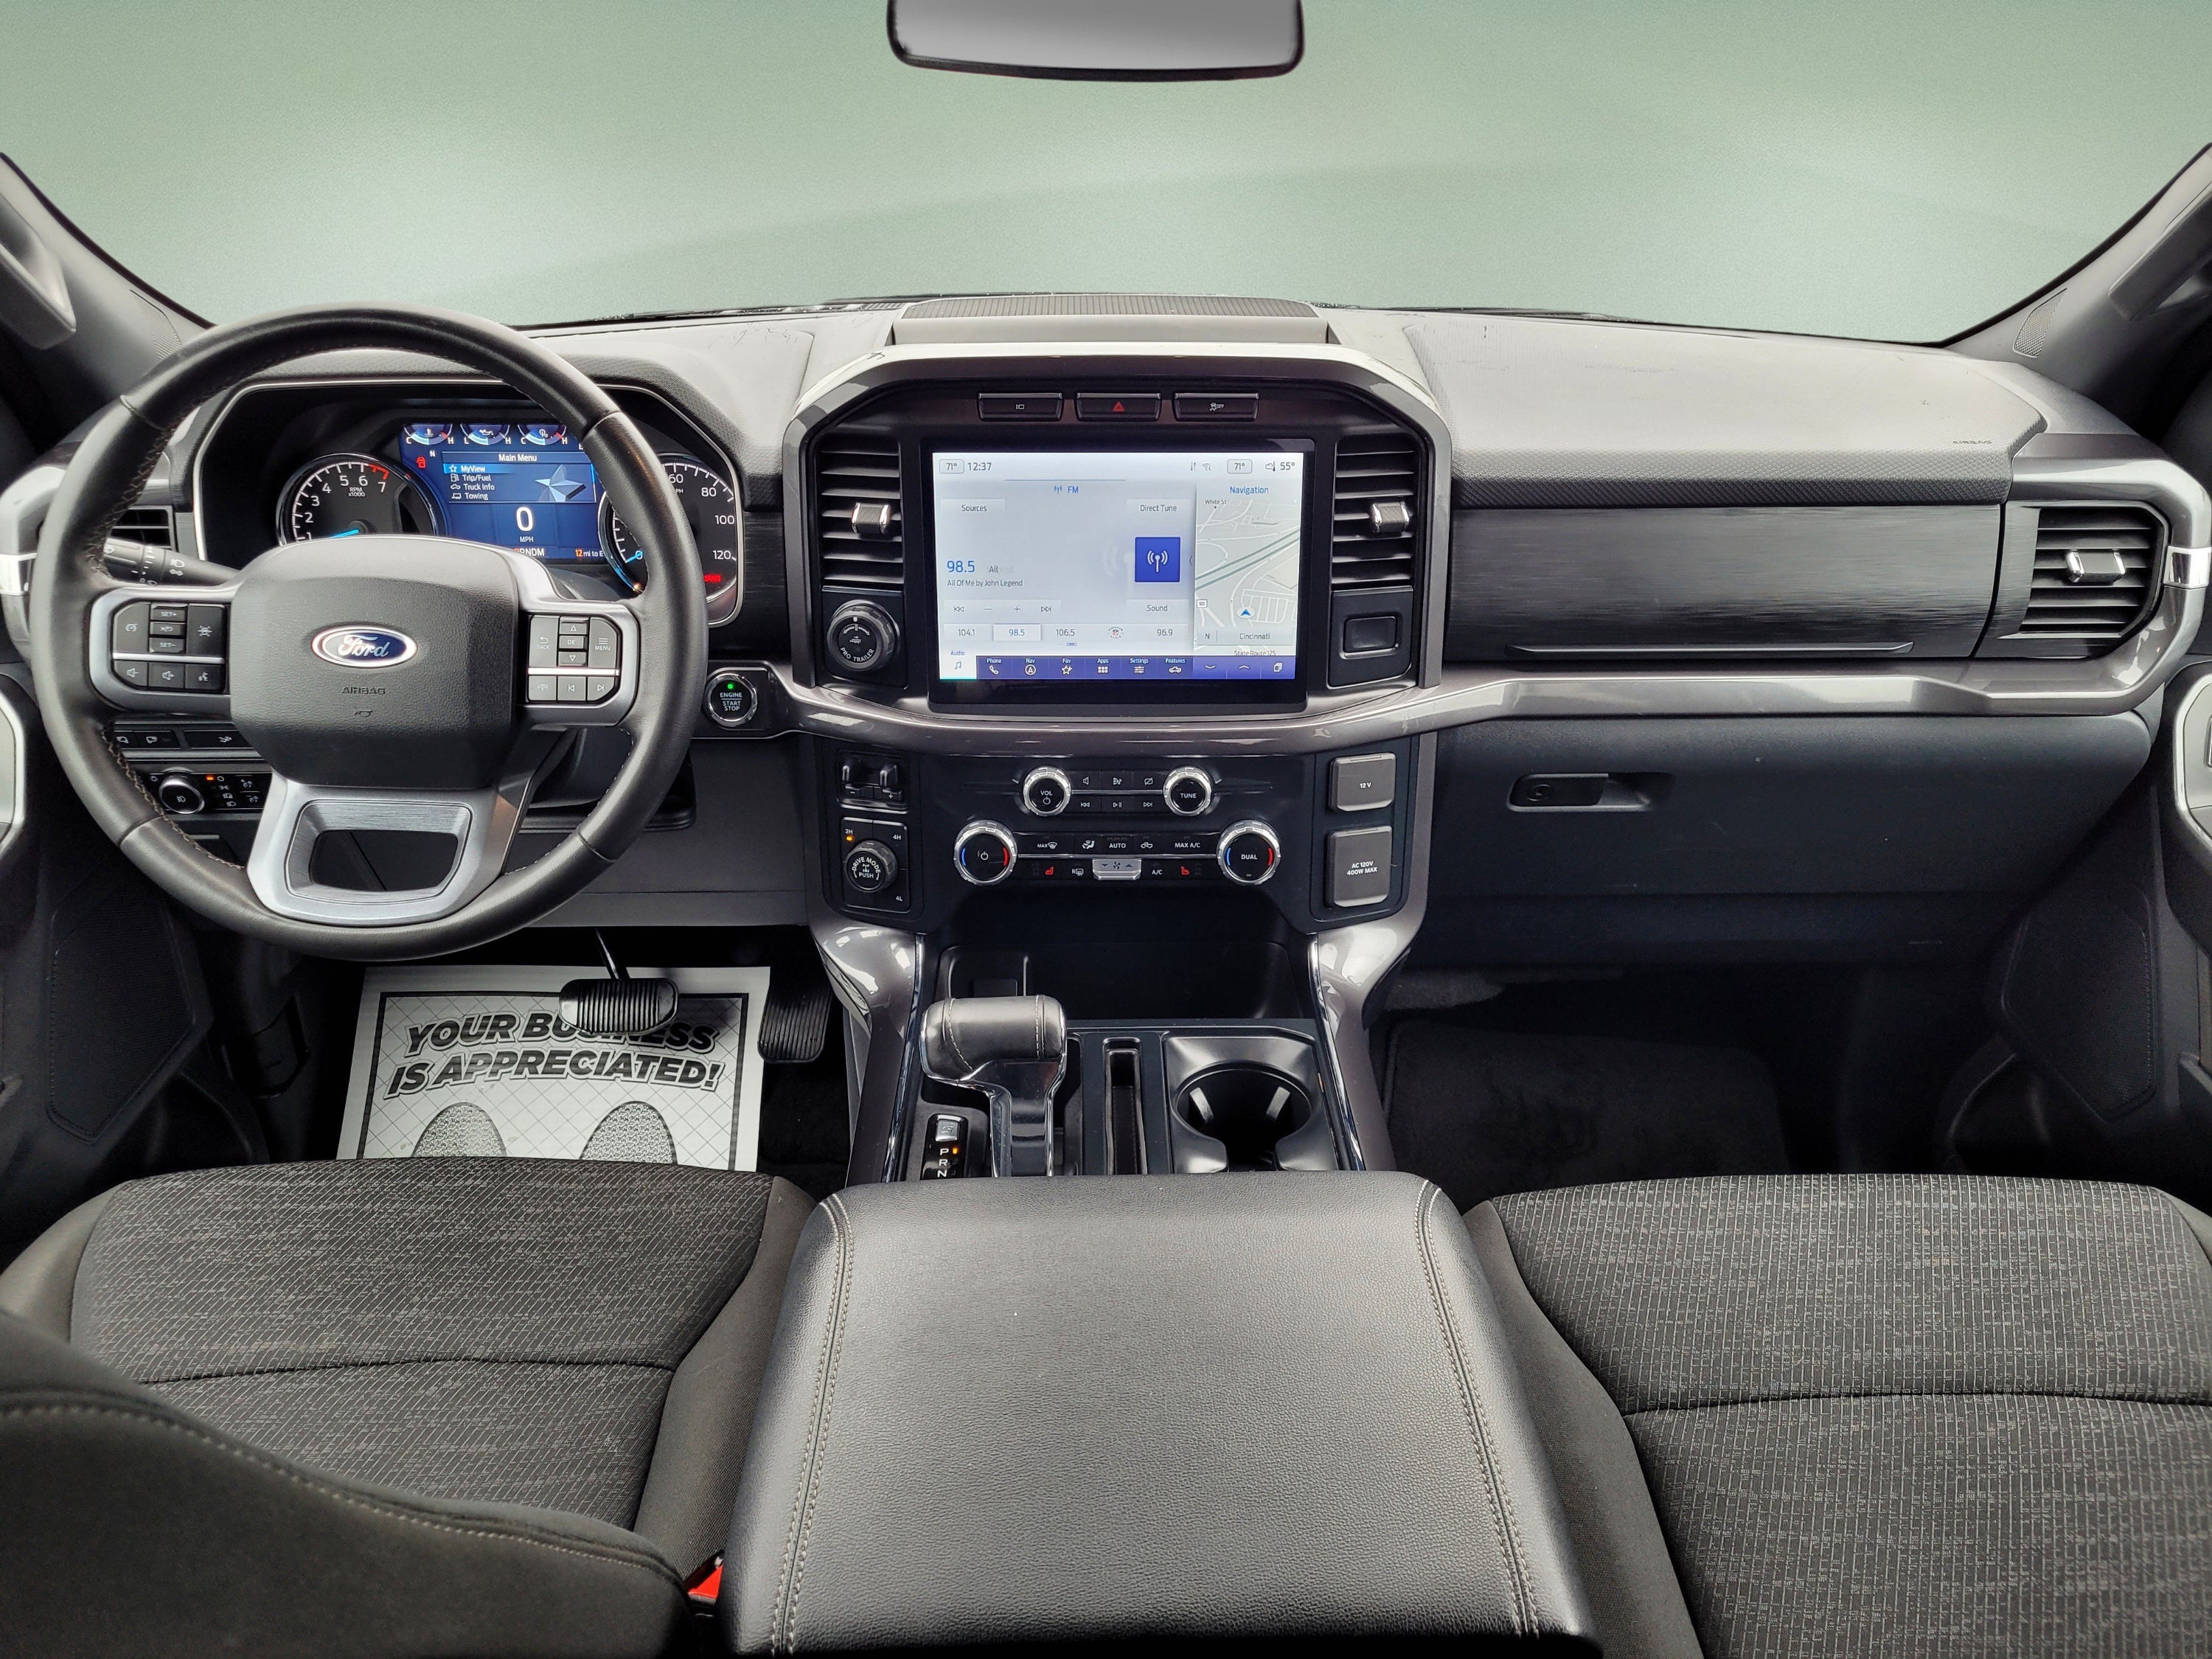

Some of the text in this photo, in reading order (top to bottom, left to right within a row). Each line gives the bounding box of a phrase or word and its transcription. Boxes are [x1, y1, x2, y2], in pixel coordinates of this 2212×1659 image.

[946, 462, 957, 470] 71°
[967, 462, 992, 471] 12:37
[1234, 462, 1245, 470] 71°
[1280, 462, 1295, 470] 55°
[340, 476, 349, 486] 5
[358, 476, 368, 486] 6
[322, 483, 332, 493] 4
[378, 482, 386, 493] 7
[701, 487, 717, 497] 80
[1068, 486, 1079, 494] FM
[1230, 486, 1269, 495] Navigation
[311, 495, 320, 506] 3
[305, 512, 313, 523] 2
[517, 507, 533, 531] 0
[714, 515, 734, 524] 100
[713, 550, 731, 560] 120
[947, 560, 975, 573] 98.5
[338, 635, 391, 657] Ford
[841, 647, 874, 662] PRO TRAILER
[341, 686, 386, 695] AIRBAG
[852, 857, 880, 873] DRIVE MODE
[407, 1013, 518, 1054] YOUR
[388, 1049, 722, 1096] IS APPRECIATED!
